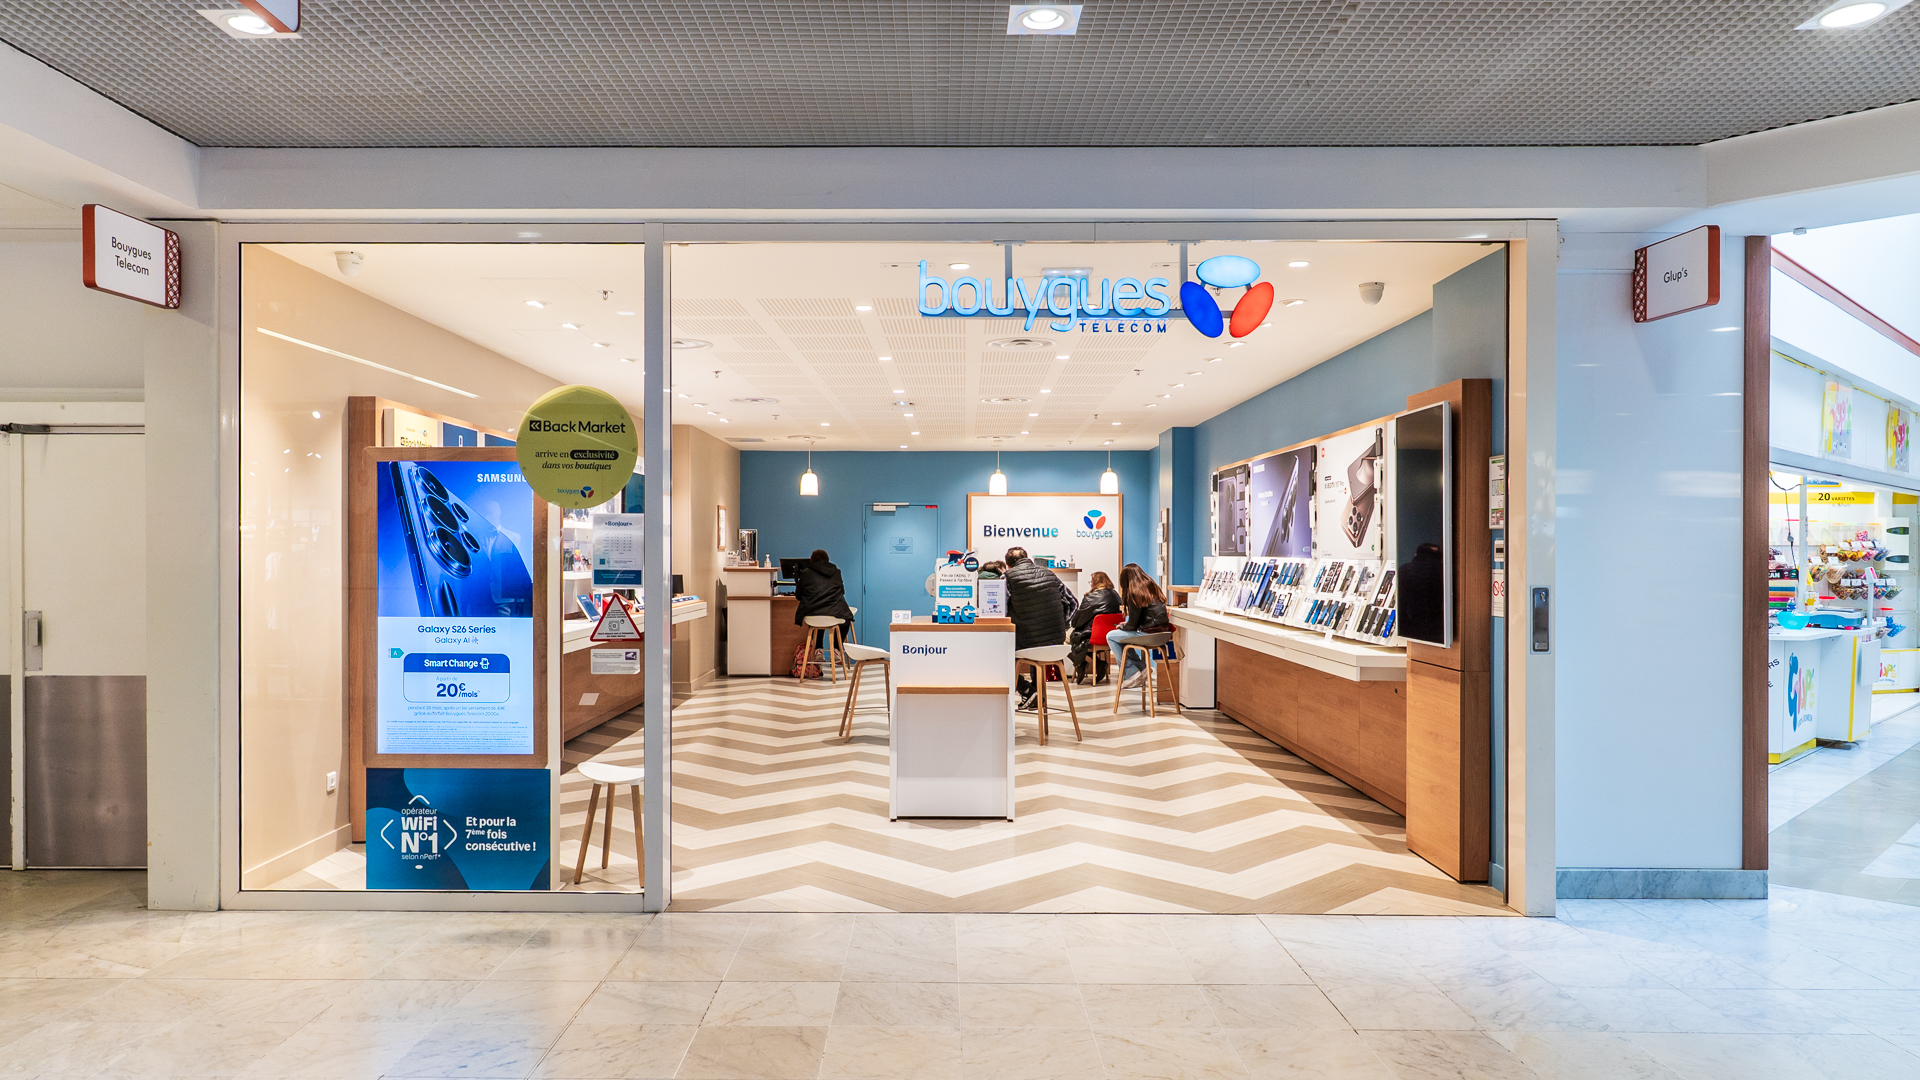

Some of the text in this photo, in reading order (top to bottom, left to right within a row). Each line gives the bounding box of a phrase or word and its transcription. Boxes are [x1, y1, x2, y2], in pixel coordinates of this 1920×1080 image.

[111, 236, 152, 260] Bouygues
[115, 254, 149, 276] Telecom
[1663, 267, 1688, 283] Glup's
[918, 259, 1171, 332] bouygues
[1079, 322, 1167, 333] TELECOM
[543, 420, 626, 434] Back Market
[535, 450, 558, 458] arrive
[573, 450, 615, 459] exclusivité
[541, 461, 561, 469] dans
[574, 462, 612, 471] boutiques
[1817, 492, 1831, 501] 20
[983, 524, 1059, 538] Bienvenue
[1076, 529, 1113, 539] bouygues
[417, 625, 497, 635] Galaxy S26 Series
[434, 636, 462, 645] Galaxy
[902, 644, 948, 656] Bonjour
[424, 659, 479, 670] Smart Change
[401, 807, 437, 816] opérateur
[400, 816, 438, 831] WiFi
[465, 816, 517, 829] Et pour la
[465, 829, 507, 839] 7ème fois
[401, 831, 439, 854] N°1
[465, 841, 537, 851] consécutive !
